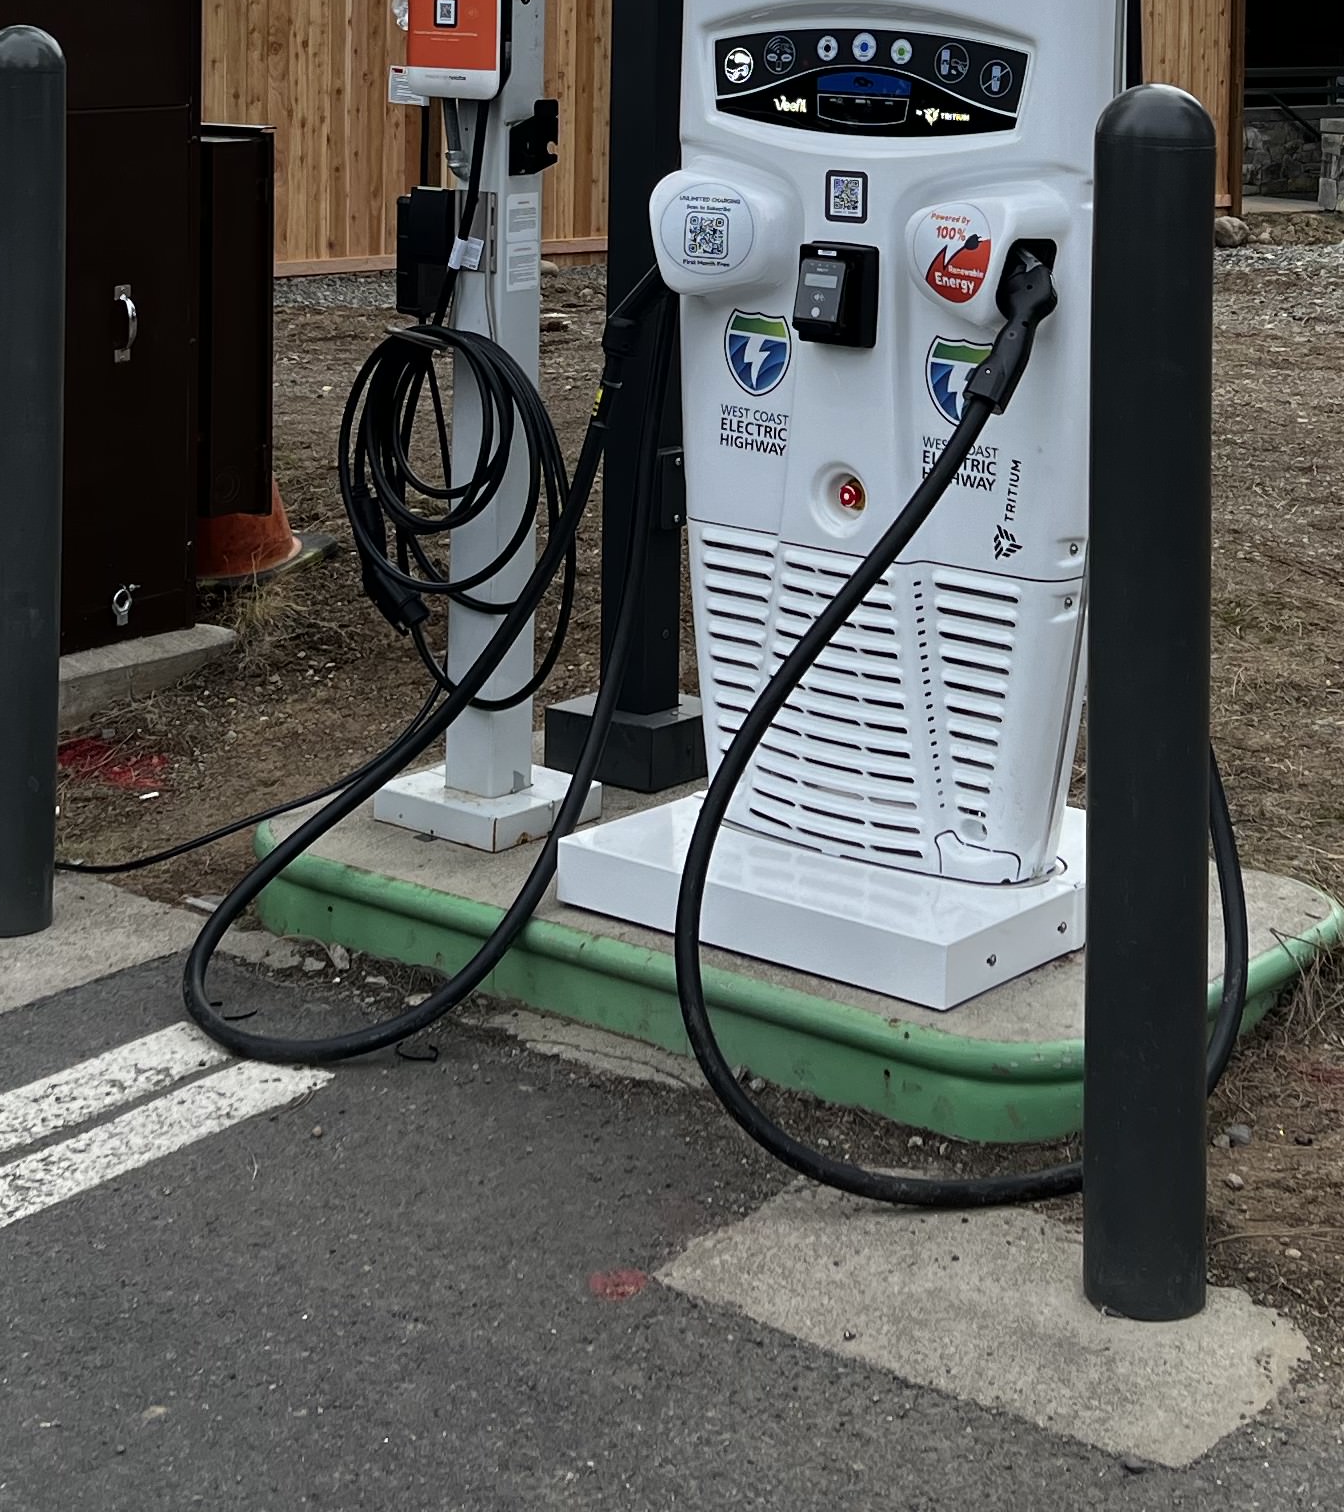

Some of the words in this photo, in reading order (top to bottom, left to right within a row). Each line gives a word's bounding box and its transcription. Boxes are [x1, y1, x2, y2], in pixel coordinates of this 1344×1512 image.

[680, 195, 710, 203] UNLIMITED
[711, 197, 741, 205] CHARGING
[931, 212, 961, 222] Powered
[936, 225, 966, 241] 100%
[948, 265, 984, 278] Renewable
[935, 272, 974, 294] Energy
[720, 404, 751, 419] WEST
[752, 408, 789, 425] COAST
[720, 418, 788, 442] ELECTRIC
[719, 433, 787, 457] HIGHWAY
[922, 436, 949, 451] WES
[967, 445, 999, 459] OAST
[923, 450, 997, 476] ELTRIC
[1004, 459, 1022, 522] TRITIUM
